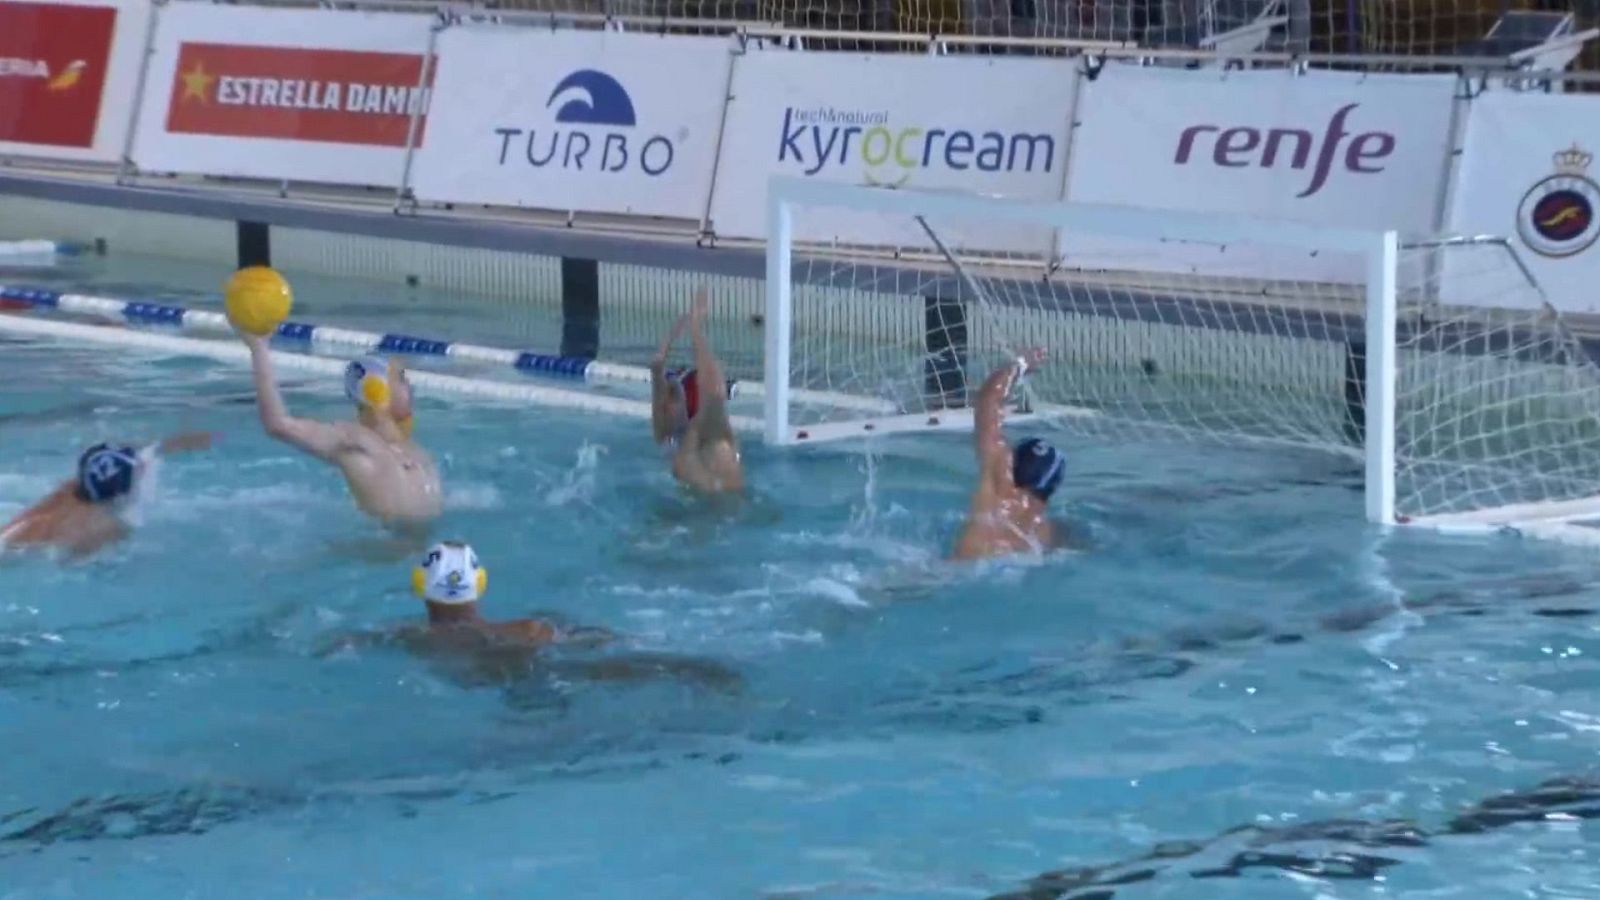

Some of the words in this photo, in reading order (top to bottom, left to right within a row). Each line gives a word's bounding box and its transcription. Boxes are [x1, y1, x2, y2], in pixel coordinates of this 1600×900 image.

[218, 76, 341, 110] ESTRELLA
[795, 106, 889, 124] tech&natural
[494, 127, 674, 176] TURBO
[778, 107, 1055, 176] kyrocream
[1173, 102, 1396, 198] renfe
